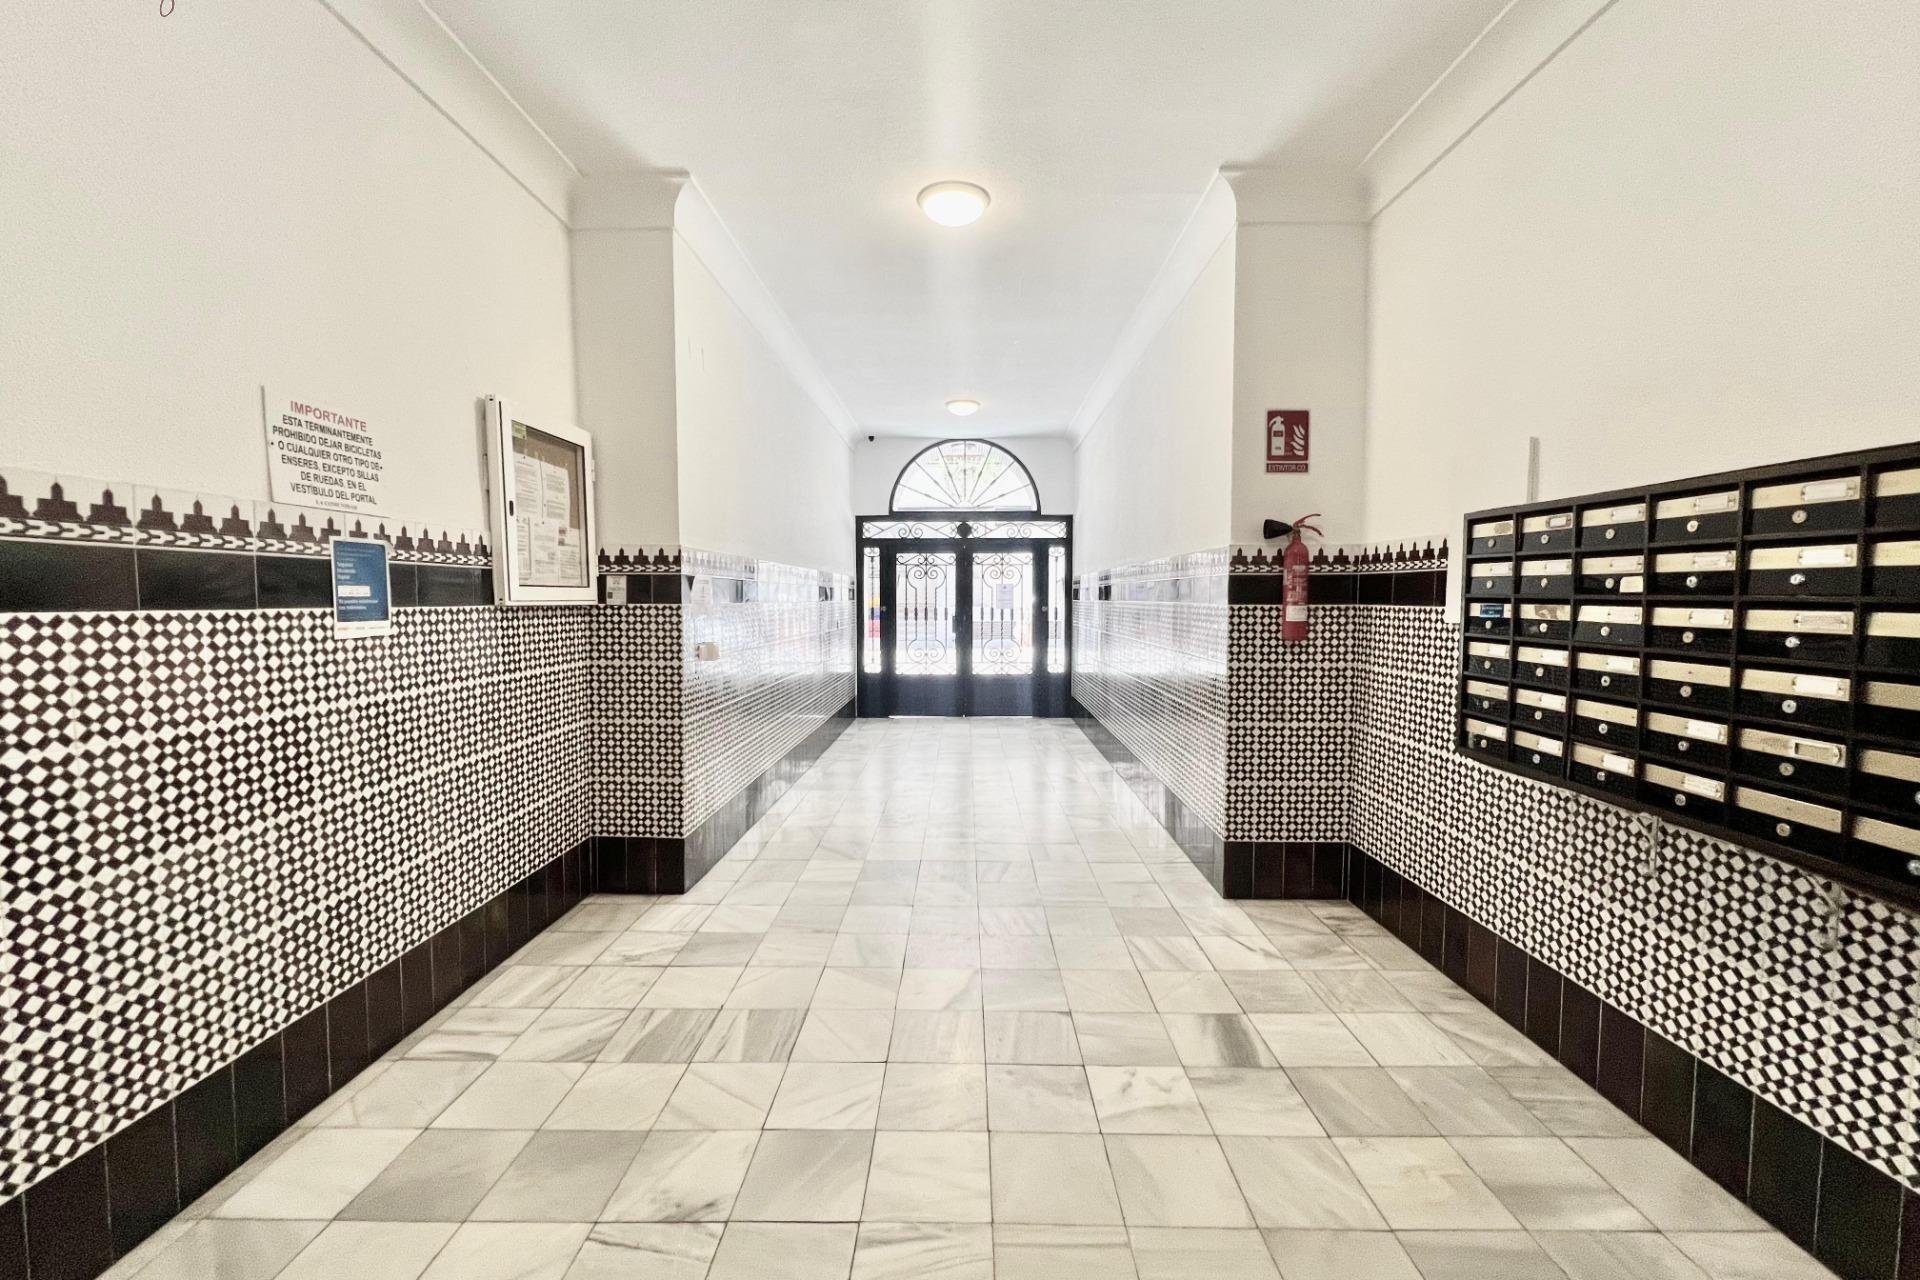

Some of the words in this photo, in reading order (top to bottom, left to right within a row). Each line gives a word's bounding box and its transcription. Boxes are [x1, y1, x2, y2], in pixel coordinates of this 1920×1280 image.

[282, 414, 302, 427] ESTA
[304, 420, 373, 446] TERMINANTEMENTE
[290, 400, 367, 432] IMPORTANTE
[273, 425, 316, 444] PROHIBIDO
[319, 437, 342, 450] DEJAR
[345, 444, 382, 459] BICICLETAS
[278, 440, 284, 449] O
[287, 443, 331, 461] CUALQUIER
[333, 453, 352, 464] OTRO
[355, 458, 369, 468] TIPO
[301, 471, 311, 481] DE
[347, 480, 356, 489] EN
[358, 482, 367, 491] EL
[322, 463, 355, 477] EXCEPTO
[356, 469, 379, 482] SILLAS
[335, 490, 349, 500] DEL
[351, 492, 377, 505] PORTAL
